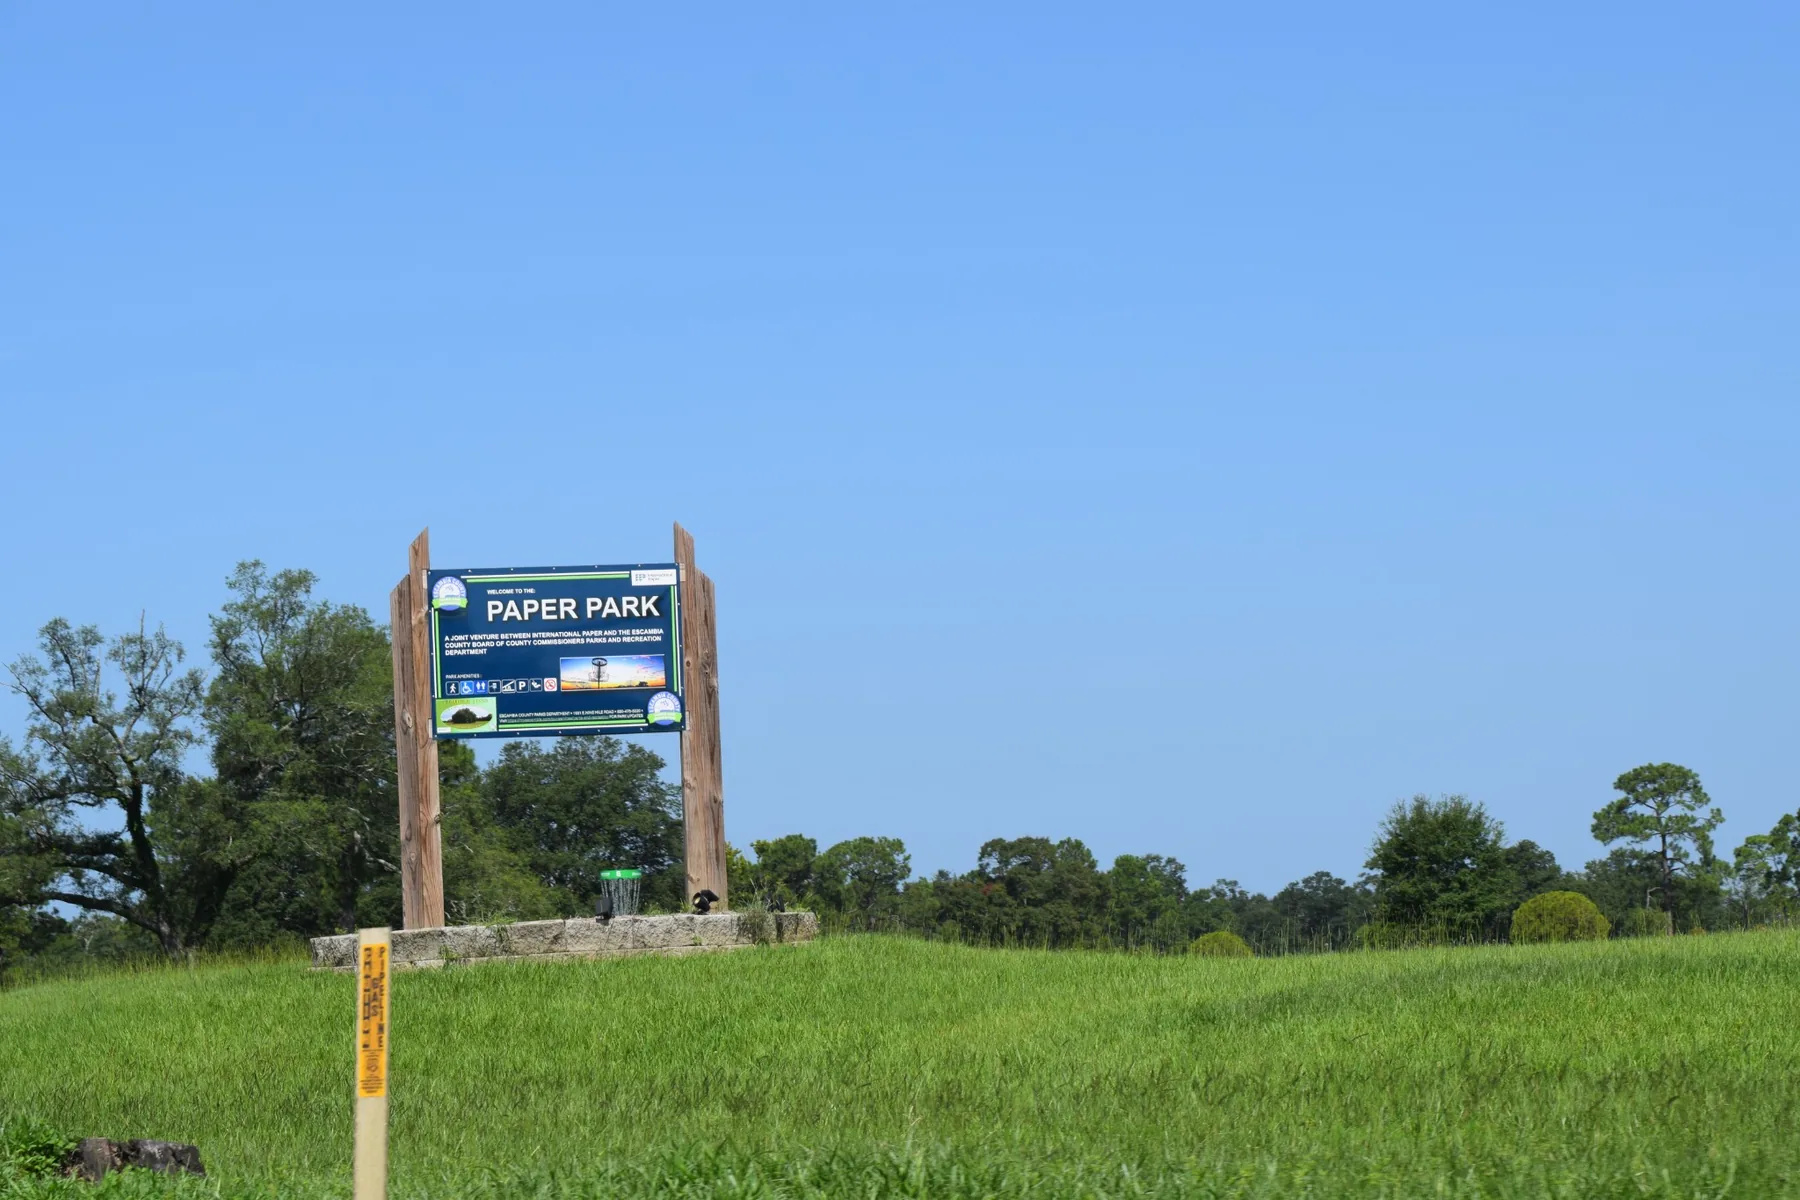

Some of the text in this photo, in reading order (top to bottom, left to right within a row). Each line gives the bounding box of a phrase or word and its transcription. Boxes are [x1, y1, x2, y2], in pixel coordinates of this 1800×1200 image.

[487, 595, 660, 622] PAPER PARK
[532, 630, 581, 638] INTERNATIONAL
[582, 629, 603, 637] PAPER
[532, 637, 585, 645] COMMISSIONERS
[622, 635, 662, 643] RECREATION
[445, 648, 487, 656] DEPARTMENT
[518, 681, 526, 691] P
[378, 946, 386, 1048] PIPELINE
